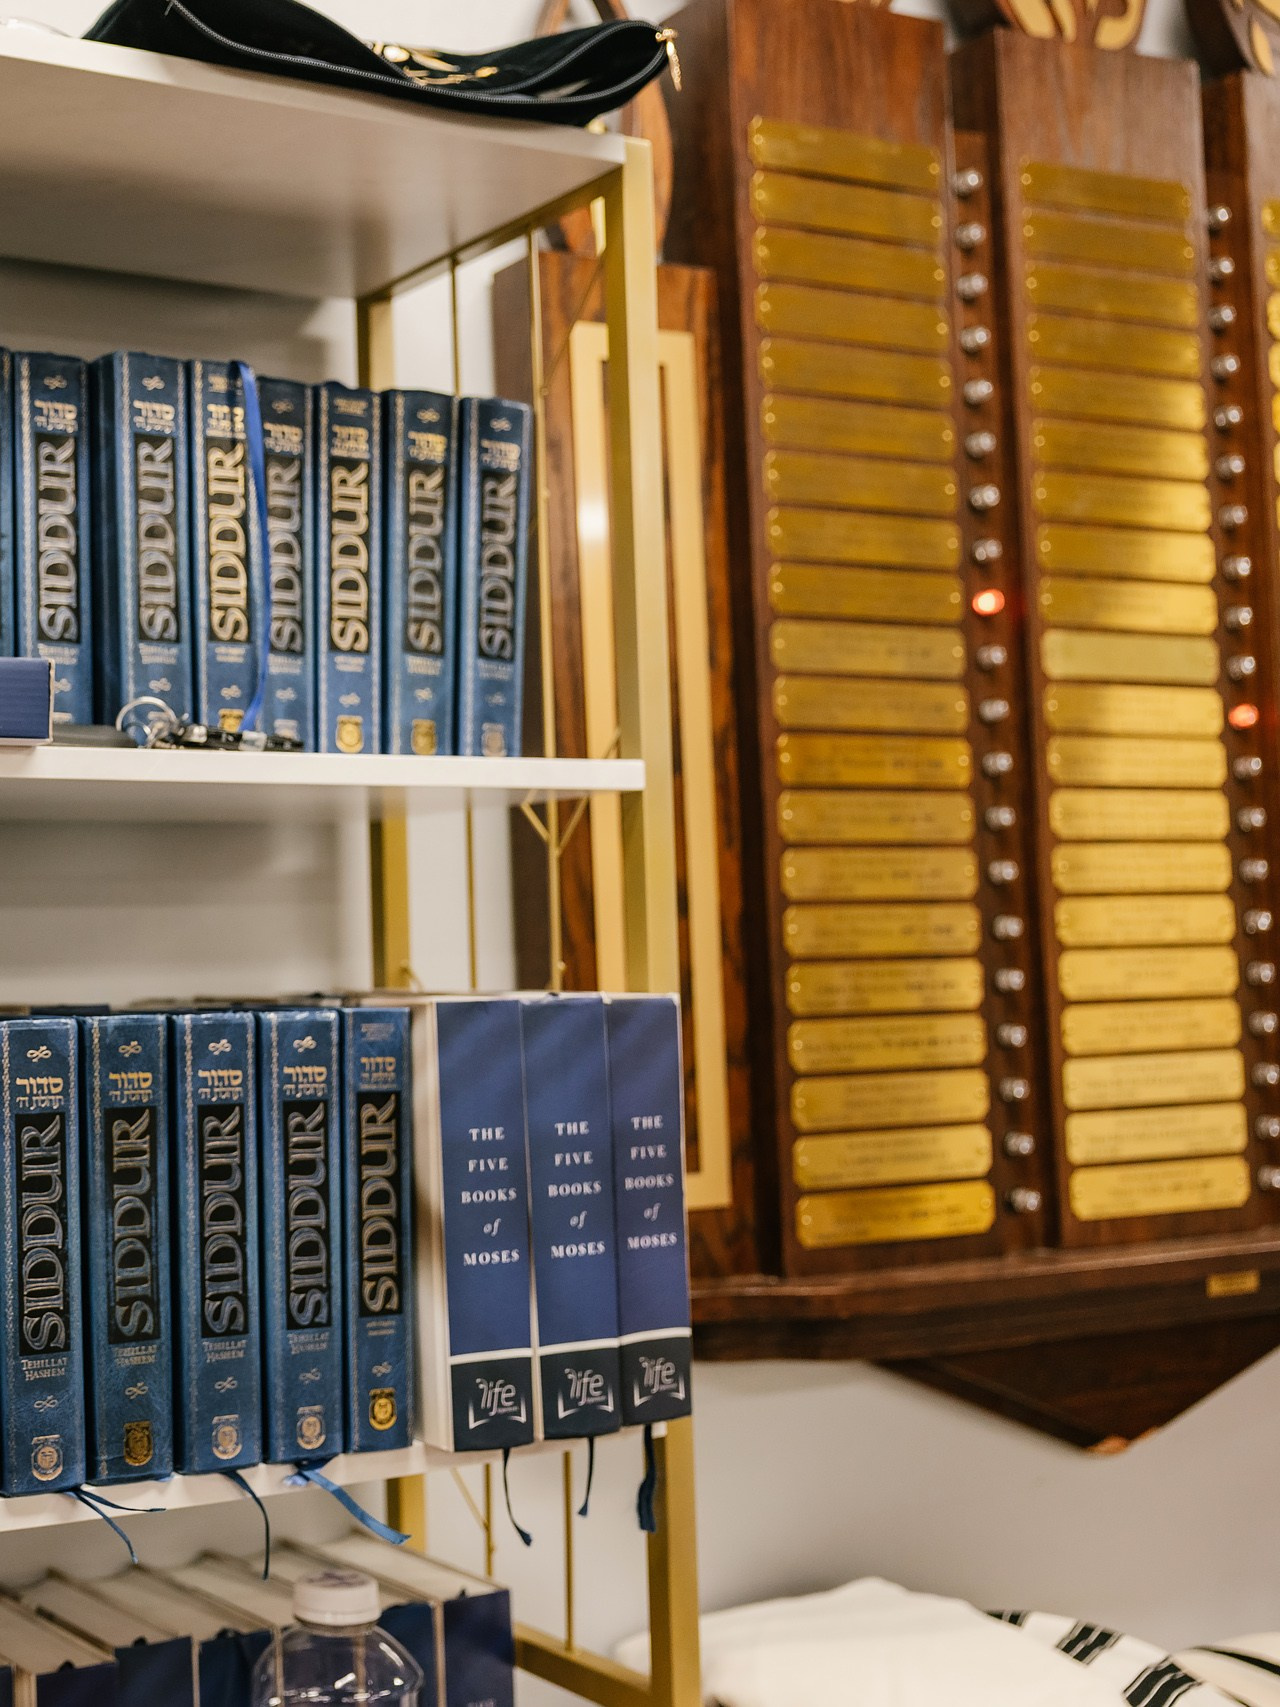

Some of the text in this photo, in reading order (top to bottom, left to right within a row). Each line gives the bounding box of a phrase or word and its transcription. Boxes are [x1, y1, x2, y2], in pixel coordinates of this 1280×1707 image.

[38, 439, 77, 642] SIDDUR
[136, 438, 176, 642] SIDDUR
[208, 441, 248, 642] SIDDUR
[266, 458, 303, 653] SIDDUR
[331, 460, 368, 653] SIDDUR
[407, 464, 445, 653] SIDDUR
[480, 473, 517, 660] SIDDUR
[109, 1072, 153, 1089] סדור
[198, 1069, 243, 1086] סדור
[283, 1065, 327, 1083] סדור
[16, 1077, 63, 1094] סדור
[555, 1121, 589, 1136] THE
[631, 1115, 663, 1130] THE
[469, 1127, 504, 1141] THE
[554, 1151, 593, 1166] FIVE
[630, 1144, 666, 1160] FIVE
[468, 1157, 508, 1172] FIVE
[548, 1181, 602, 1197] BOOKS
[625, 1173, 674, 1190] BOOKS
[359, 1093, 400, 1314] SIDDUR
[461, 1187, 517, 1204] BOOKS
[203, 1105, 244, 1336] SIDDUR
[287, 1102, 329, 1327] SIDDUR
[570, 1211, 586, 1229] of
[643, 1203, 660, 1221] of
[112, 1109, 155, 1337] SIDDUR
[483, 1218, 501, 1235] of
[21, 1115, 65, 1350] SIDDUR
[627, 1232, 677, 1250] MOSES
[463, 1249, 519, 1266] MOSES
[550, 1241, 605, 1258] MOSES
